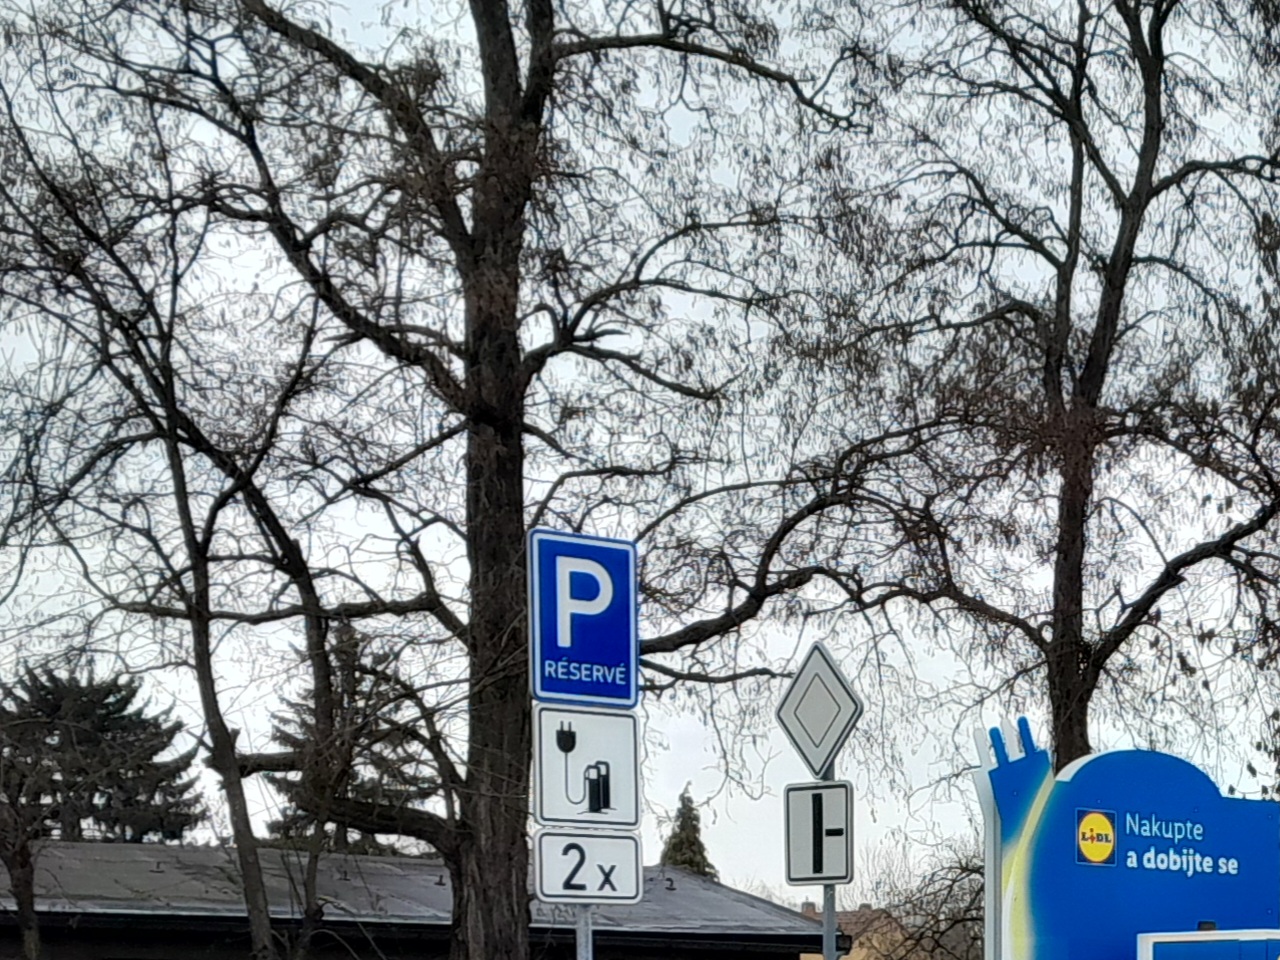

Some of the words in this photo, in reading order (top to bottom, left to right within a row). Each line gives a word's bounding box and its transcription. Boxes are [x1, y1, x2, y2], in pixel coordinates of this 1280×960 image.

[555, 555, 614, 648] P
[544, 656, 627, 686] RÉSERVÉ
[1125, 812, 1204, 845] Nakupte
[1126, 850, 1138, 868] a
[1142, 846, 1213, 878] dobijte
[1218, 856, 1239, 875] se
